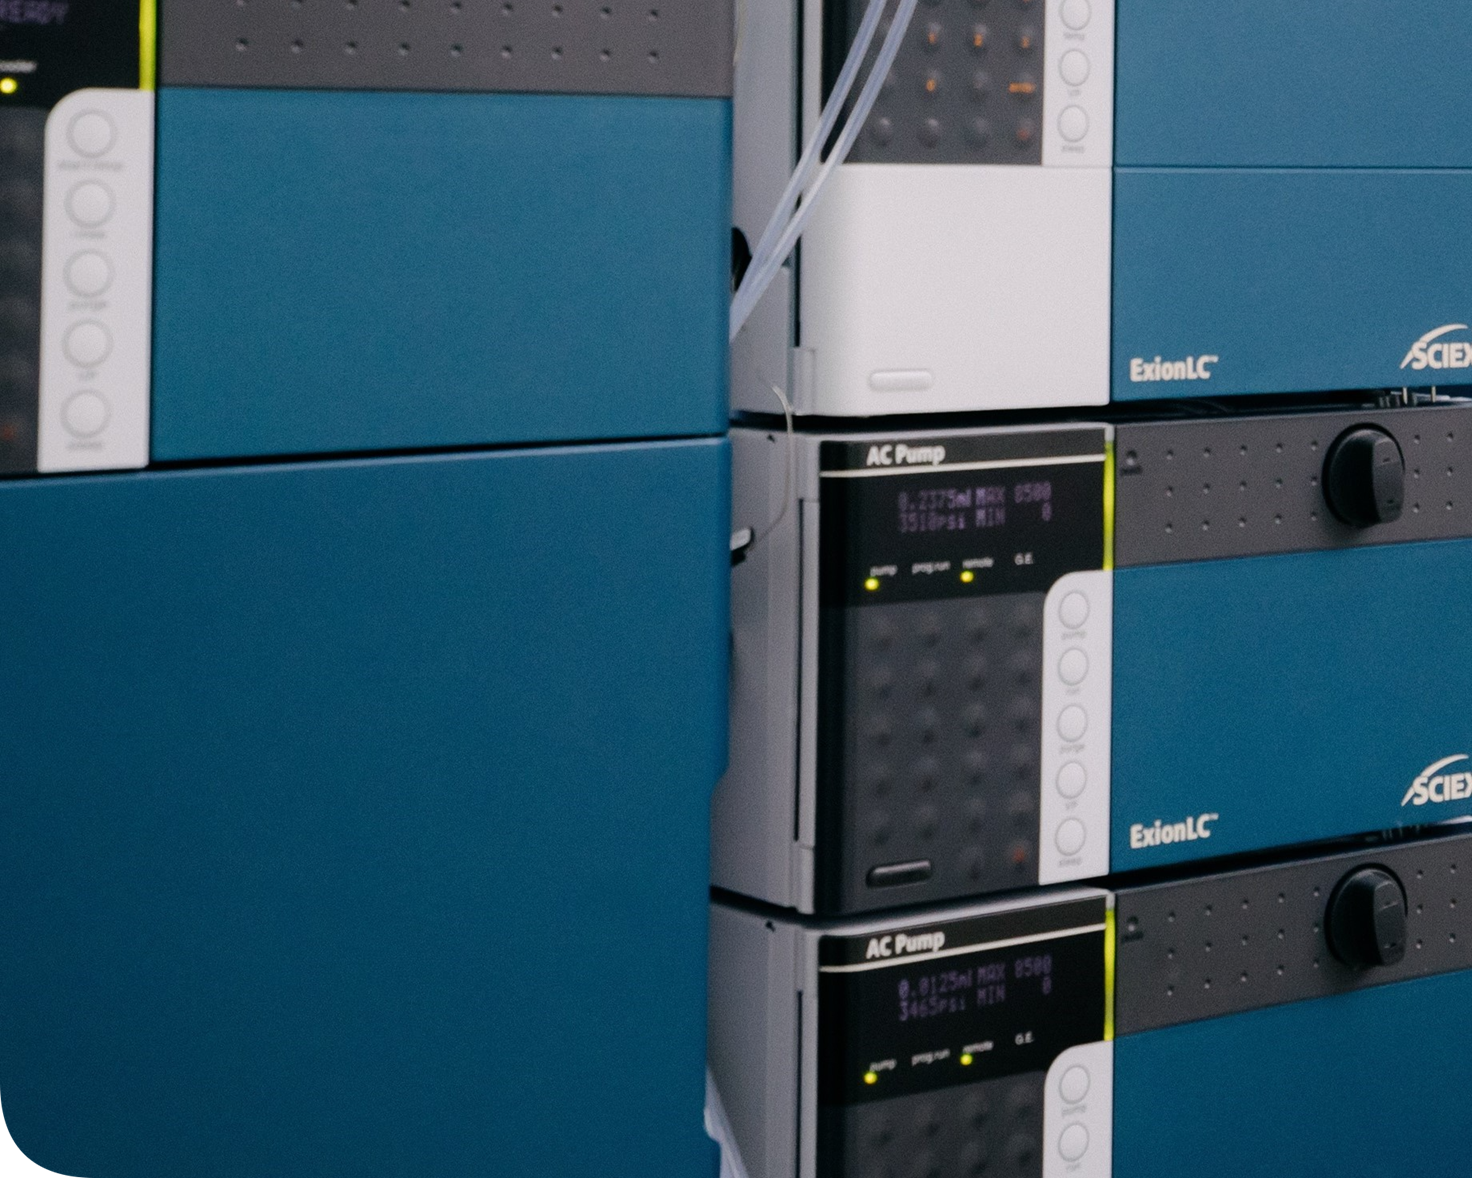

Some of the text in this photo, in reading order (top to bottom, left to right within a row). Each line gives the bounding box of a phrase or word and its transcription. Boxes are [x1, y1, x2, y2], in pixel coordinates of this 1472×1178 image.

[867, 443, 946, 466] AC Pump
[866, 931, 946, 959] AC Pump
